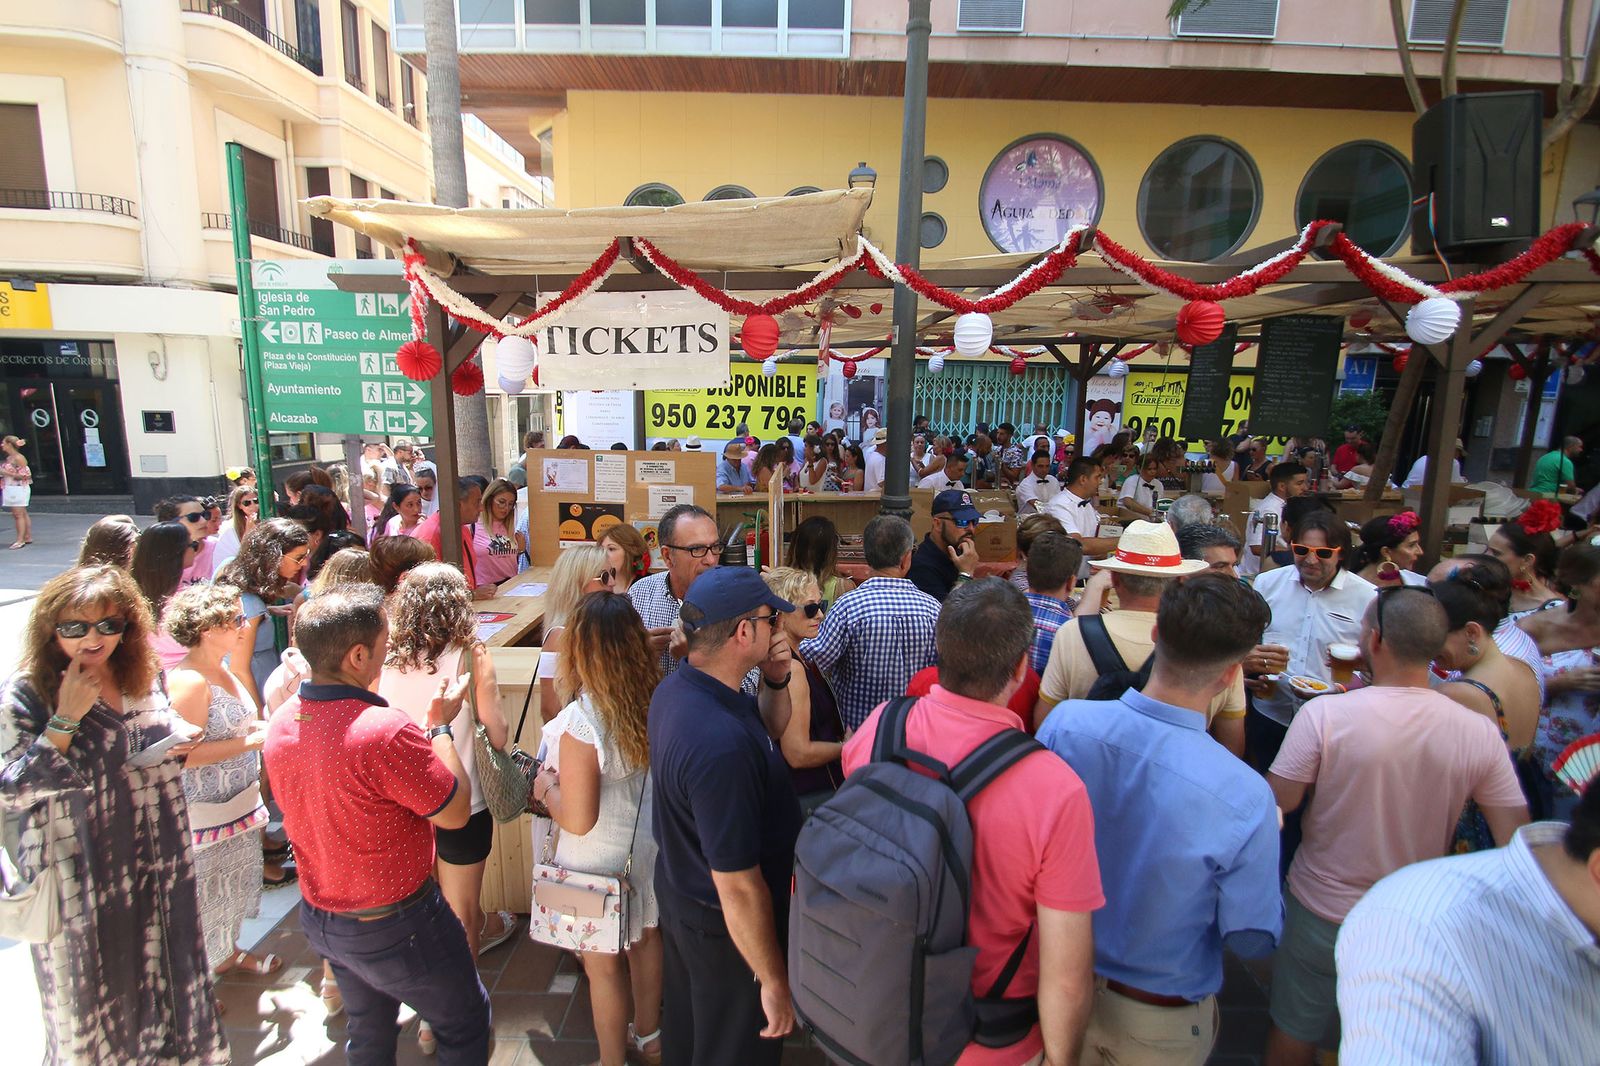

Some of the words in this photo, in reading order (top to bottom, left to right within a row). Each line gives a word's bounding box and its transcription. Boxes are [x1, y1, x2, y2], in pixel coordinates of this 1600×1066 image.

[258, 291, 293, 304] Iglesia
[295, 292, 309, 303] de
[259, 304, 280, 316] San
[282, 305, 315, 317] Pedro
[324, 328, 358, 341] Paseo
[362, 328, 376, 341] de
[379, 329, 414, 342] Almer
[547, 322, 718, 356] TICKETS
[55, 356, 70, 365] DE
[263, 351, 284, 361] Plaza
[286, 352, 295, 361] de
[299, 352, 305, 361] la
[307, 352, 357, 362] Constitución
[264, 361, 286, 371] (Plaza
[288, 361, 311, 372] Vieja)
[267, 382, 342, 396] Ayuntamiento
[270, 412, 318, 425] Alcazaba
[651, 403, 697, 428] 950
[706, 404, 751, 429] 237
[761, 406, 806, 430] 796
